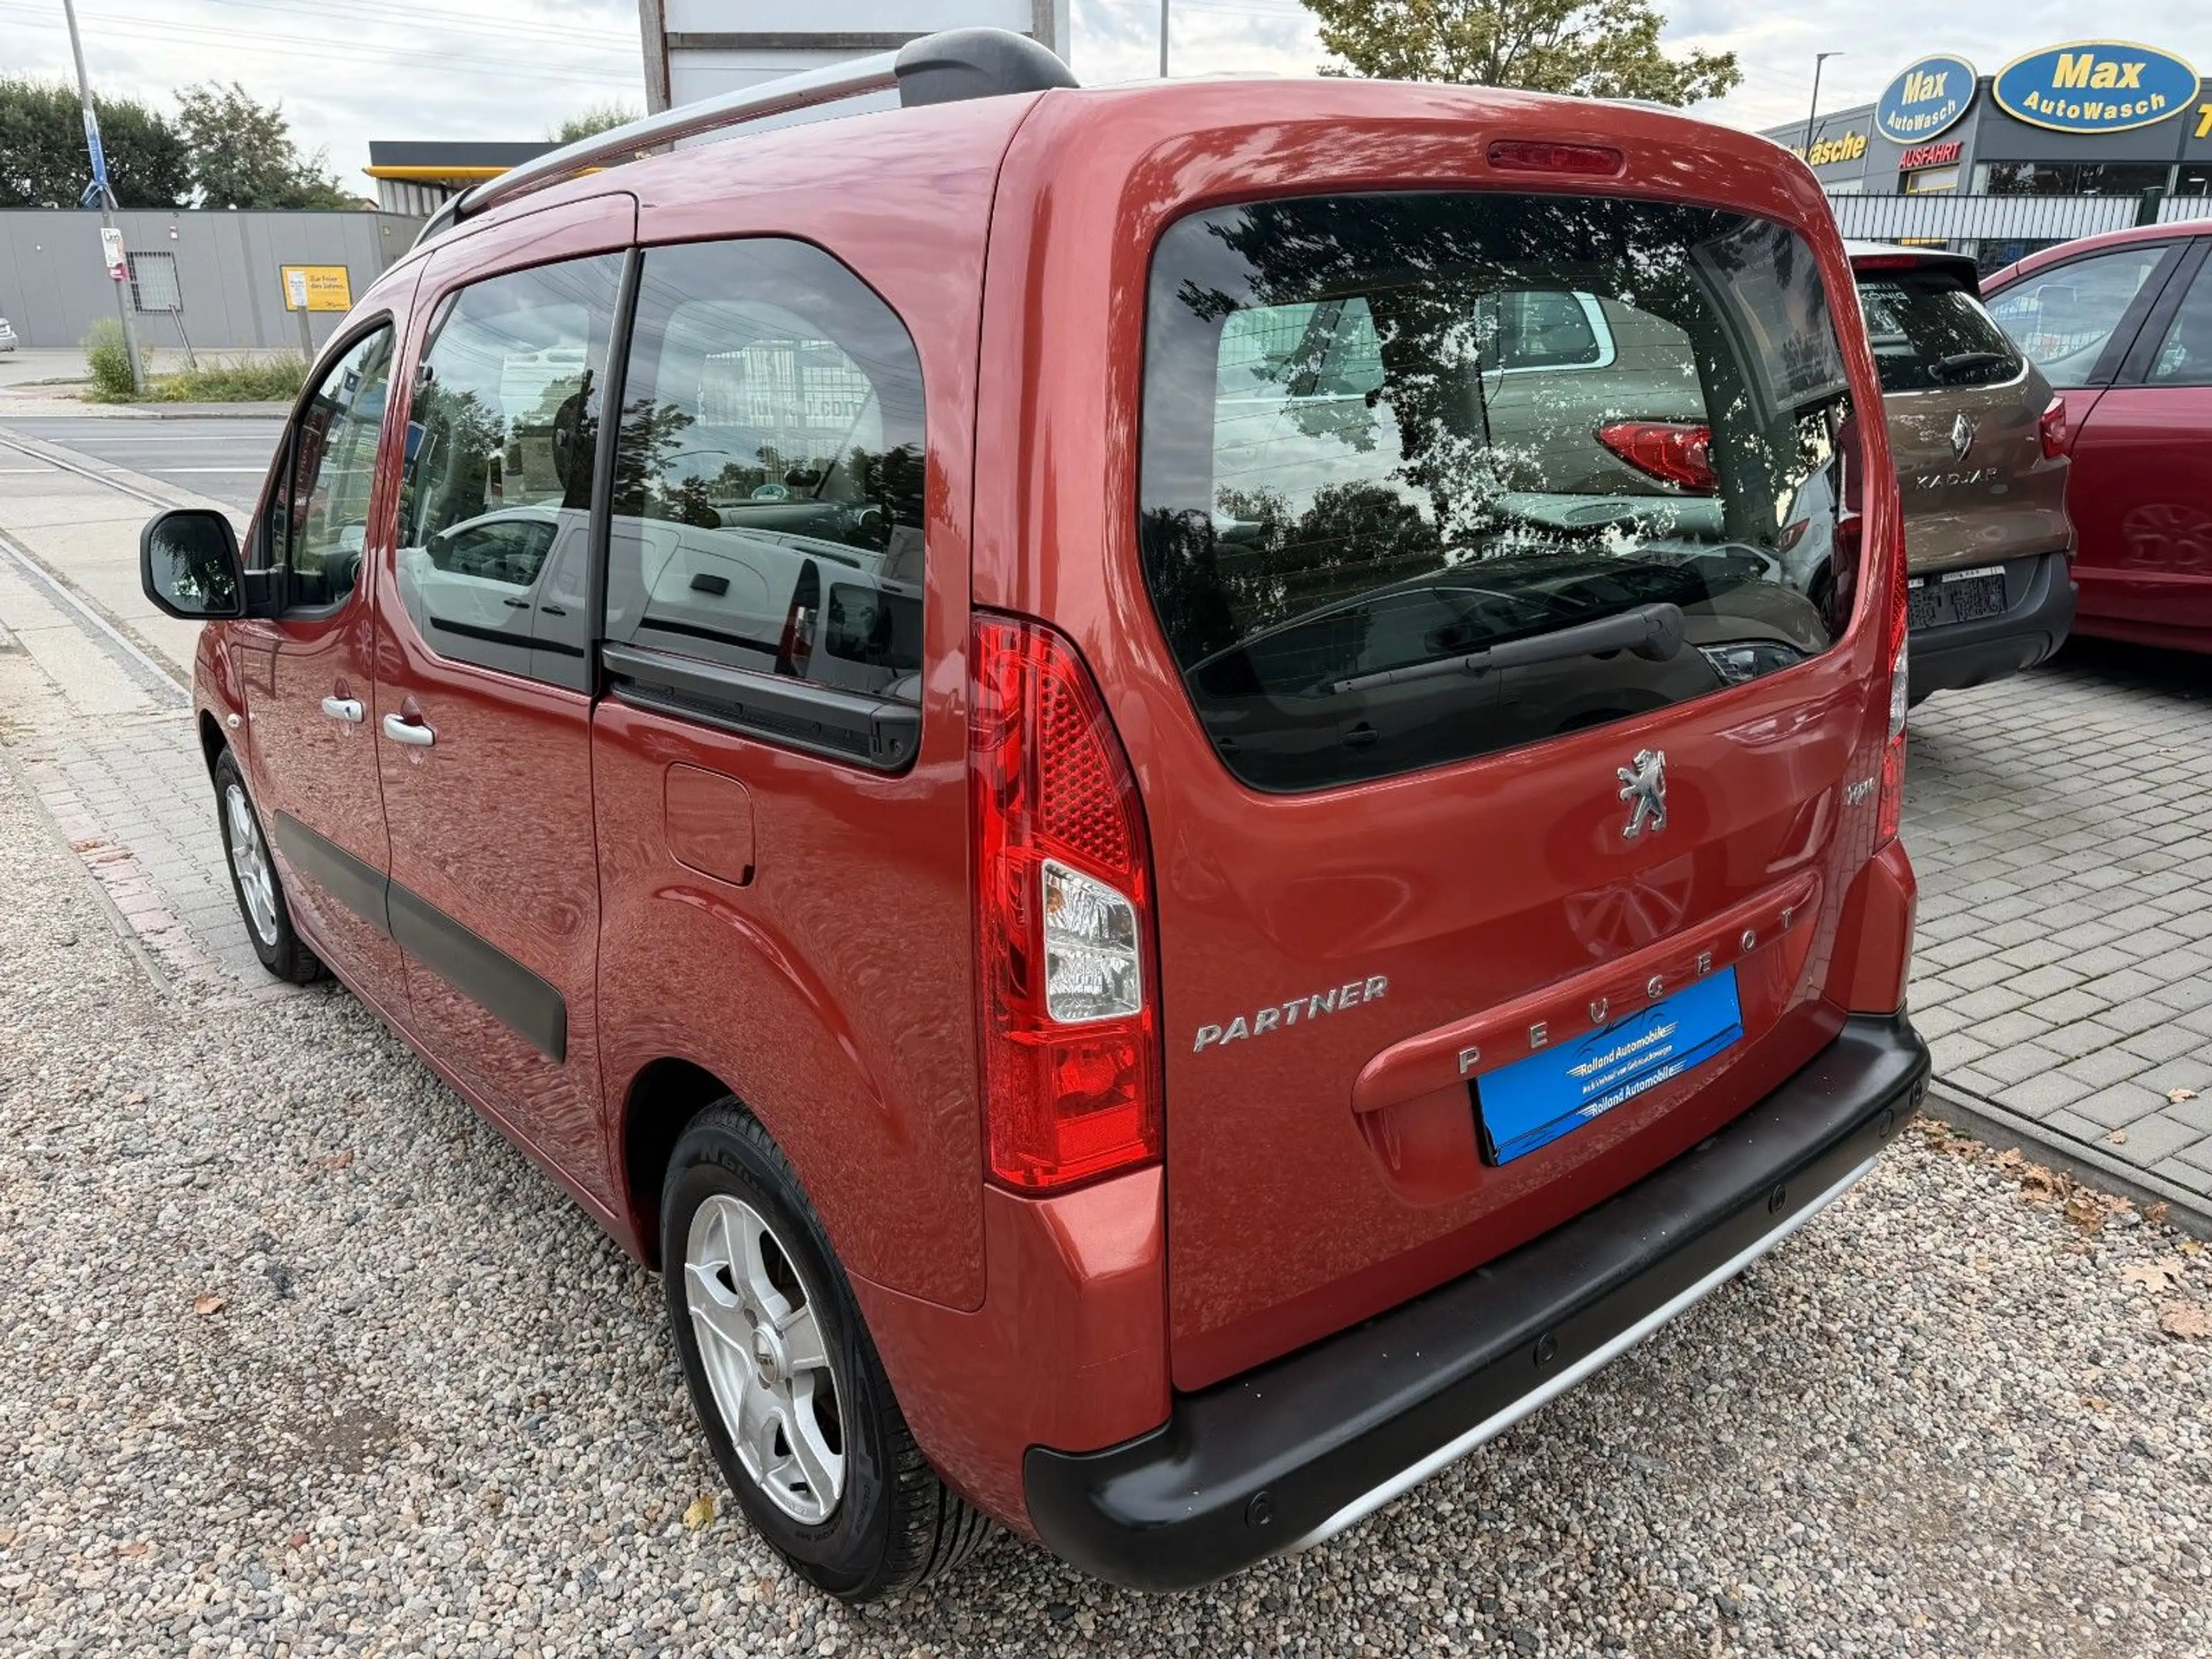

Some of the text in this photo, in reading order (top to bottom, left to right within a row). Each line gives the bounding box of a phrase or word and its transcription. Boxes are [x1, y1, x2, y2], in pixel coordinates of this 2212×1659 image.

[1902, 70, 1949, 105] Max
[2052, 54, 2146, 88] Max
[1887, 99, 1956, 131] AutoWasch
[2023, 90, 2165, 120] AutoWasch
[1899, 141, 1960, 168] AUSFAHRT
[1459, 907, 1793, 1074] PEUGEOT
[1193, 976, 1388, 1054] PARTNER
[1581, 1025, 1665, 1076] Rolland Automobile
[1592, 1066, 1673, 1117] Rolland Automobile
